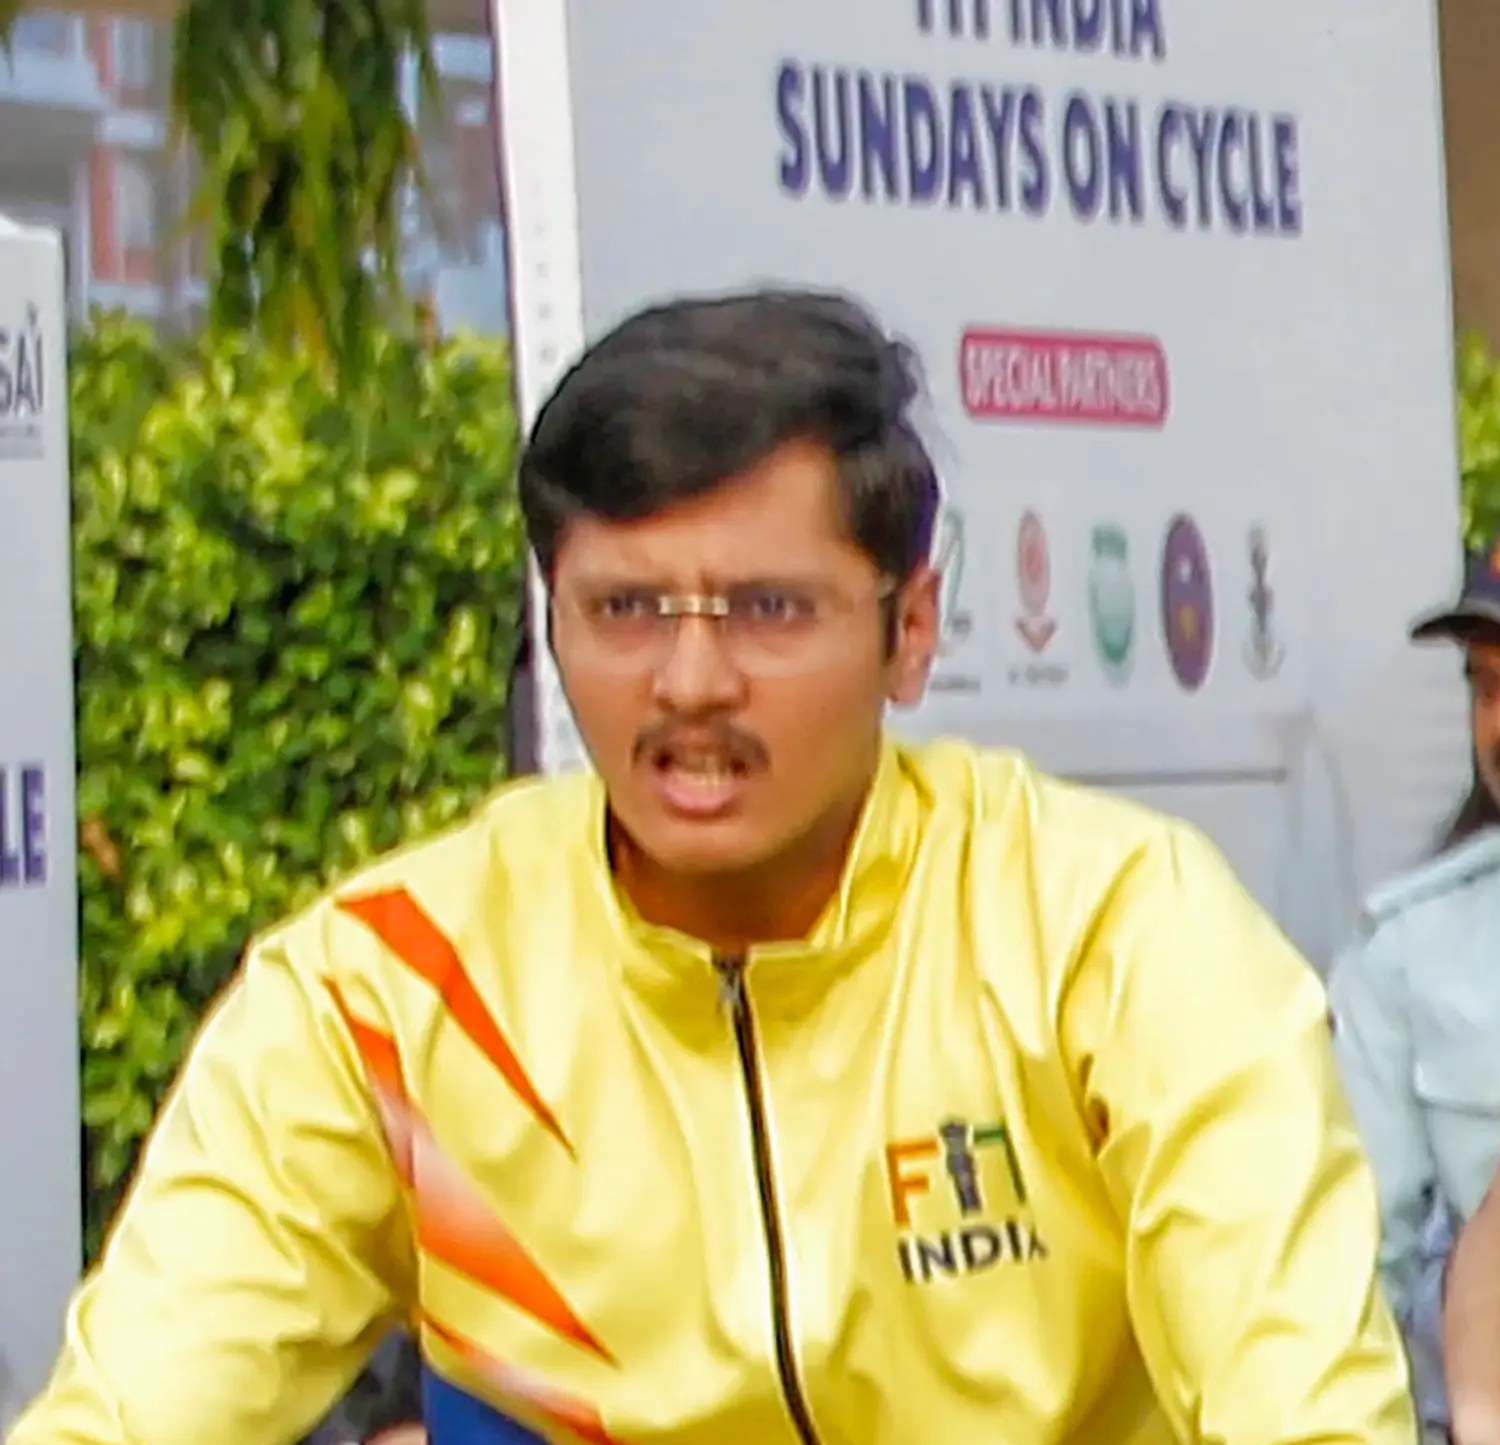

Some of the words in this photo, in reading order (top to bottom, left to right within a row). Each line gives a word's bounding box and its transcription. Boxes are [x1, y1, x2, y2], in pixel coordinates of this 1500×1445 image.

[774, 58, 1052, 220] SUNDAYS
[1064, 88, 1145, 225] ON
[1157, 102, 1302, 237] CYCLE
[966, 343, 1055, 411] SPECIAL
[1059, 349, 1162, 418] PARTNERS
[885, 1118, 1026, 1228] FIT
[897, 1215, 1048, 1285] INDIA
